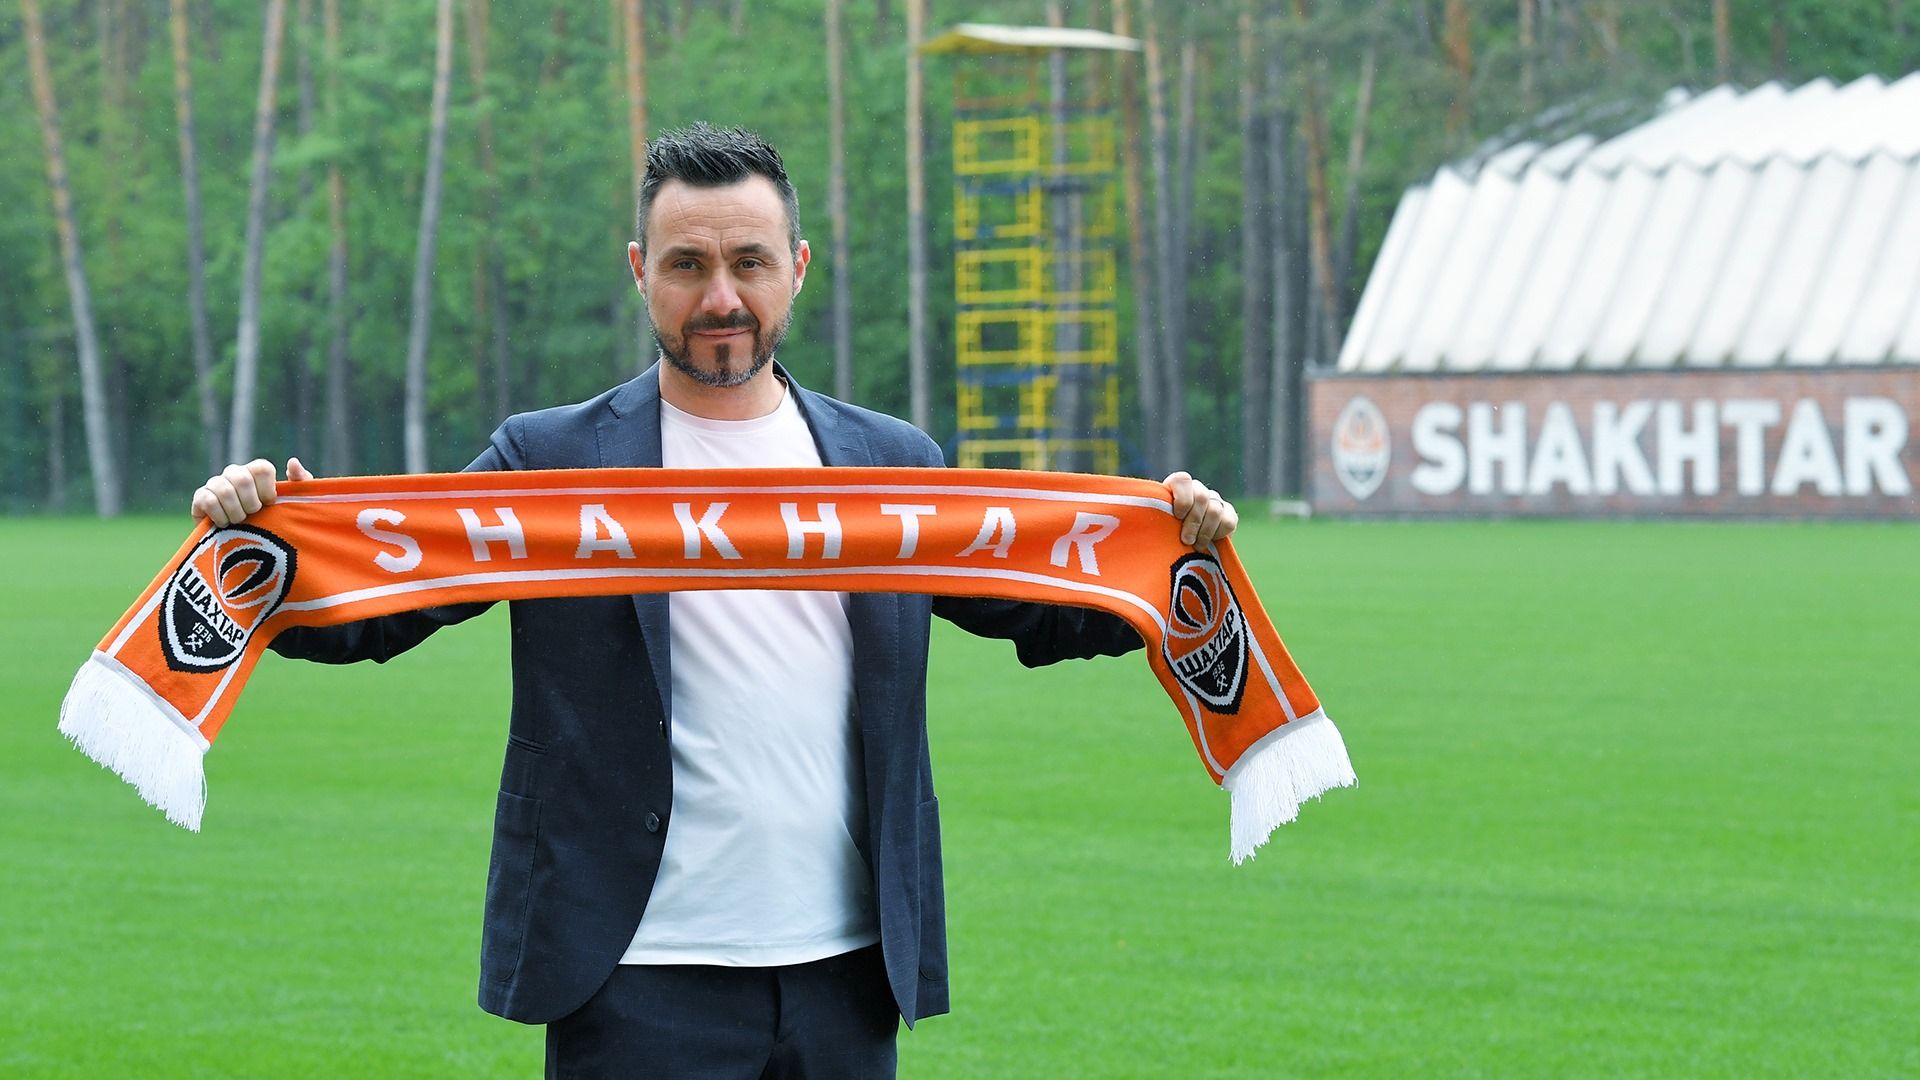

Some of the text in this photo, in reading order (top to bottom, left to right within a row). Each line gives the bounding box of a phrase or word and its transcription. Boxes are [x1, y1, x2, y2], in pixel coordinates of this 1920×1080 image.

[1411, 397, 1911, 495] SHAKHTAR
[355, 503, 1120, 576] SHAKHTAR
[178, 567, 245, 643] ШАХТАР
[192, 622, 214, 643] 1936
[1178, 608, 1234, 678] ШАХТАР
